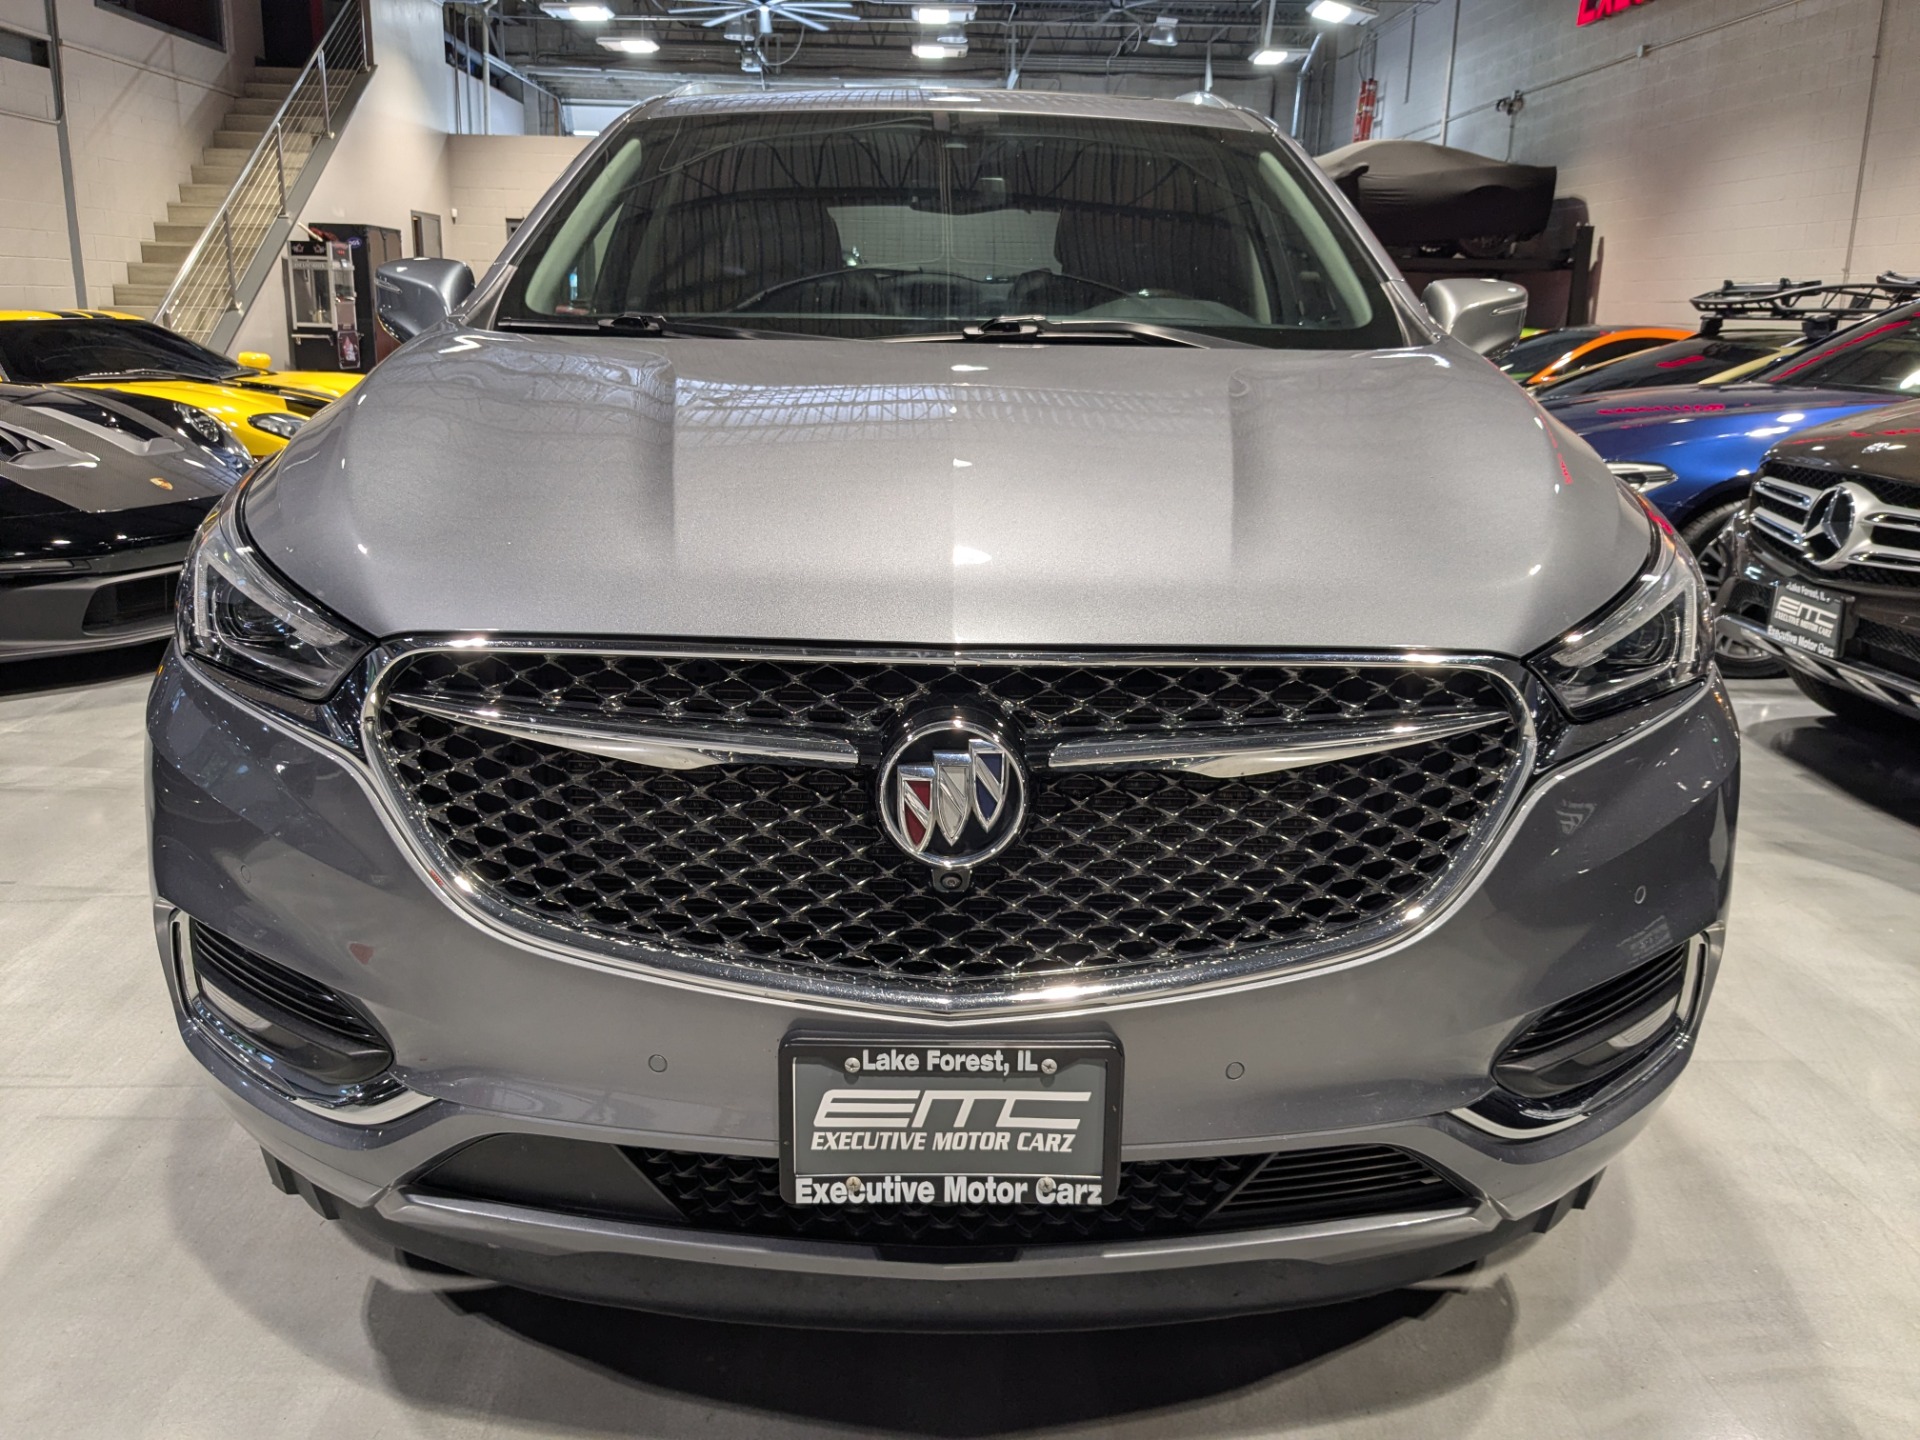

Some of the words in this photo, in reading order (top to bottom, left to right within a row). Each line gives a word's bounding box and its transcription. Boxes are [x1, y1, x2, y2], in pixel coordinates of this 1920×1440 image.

[1774, 611, 1800, 626] EXECUTIVE
[1800, 619, 1819, 633] MOTOR
[1818, 626, 1832, 638] CARZ
[1776, 596, 1838, 629] EMC
[1767, 624, 1798, 644] Executive
[1798, 635, 1818, 652] Motor
[1817, 643, 1834, 658] Carz
[862, 1049, 920, 1071] Lake
[927, 1050, 1010, 1076] Forest,
[1017, 1050, 1039, 1071] IL
[813, 1089, 1092, 1129] EMC
[810, 1131, 927, 1150] EXECUTIVE
[932, 1132, 1011, 1151] MOTOR
[1016, 1132, 1076, 1153] CARZ
[795, 1175, 936, 1204] Executive
[944, 1176, 1028, 1204] Motor
[1035, 1177, 1102, 1205] Carz
